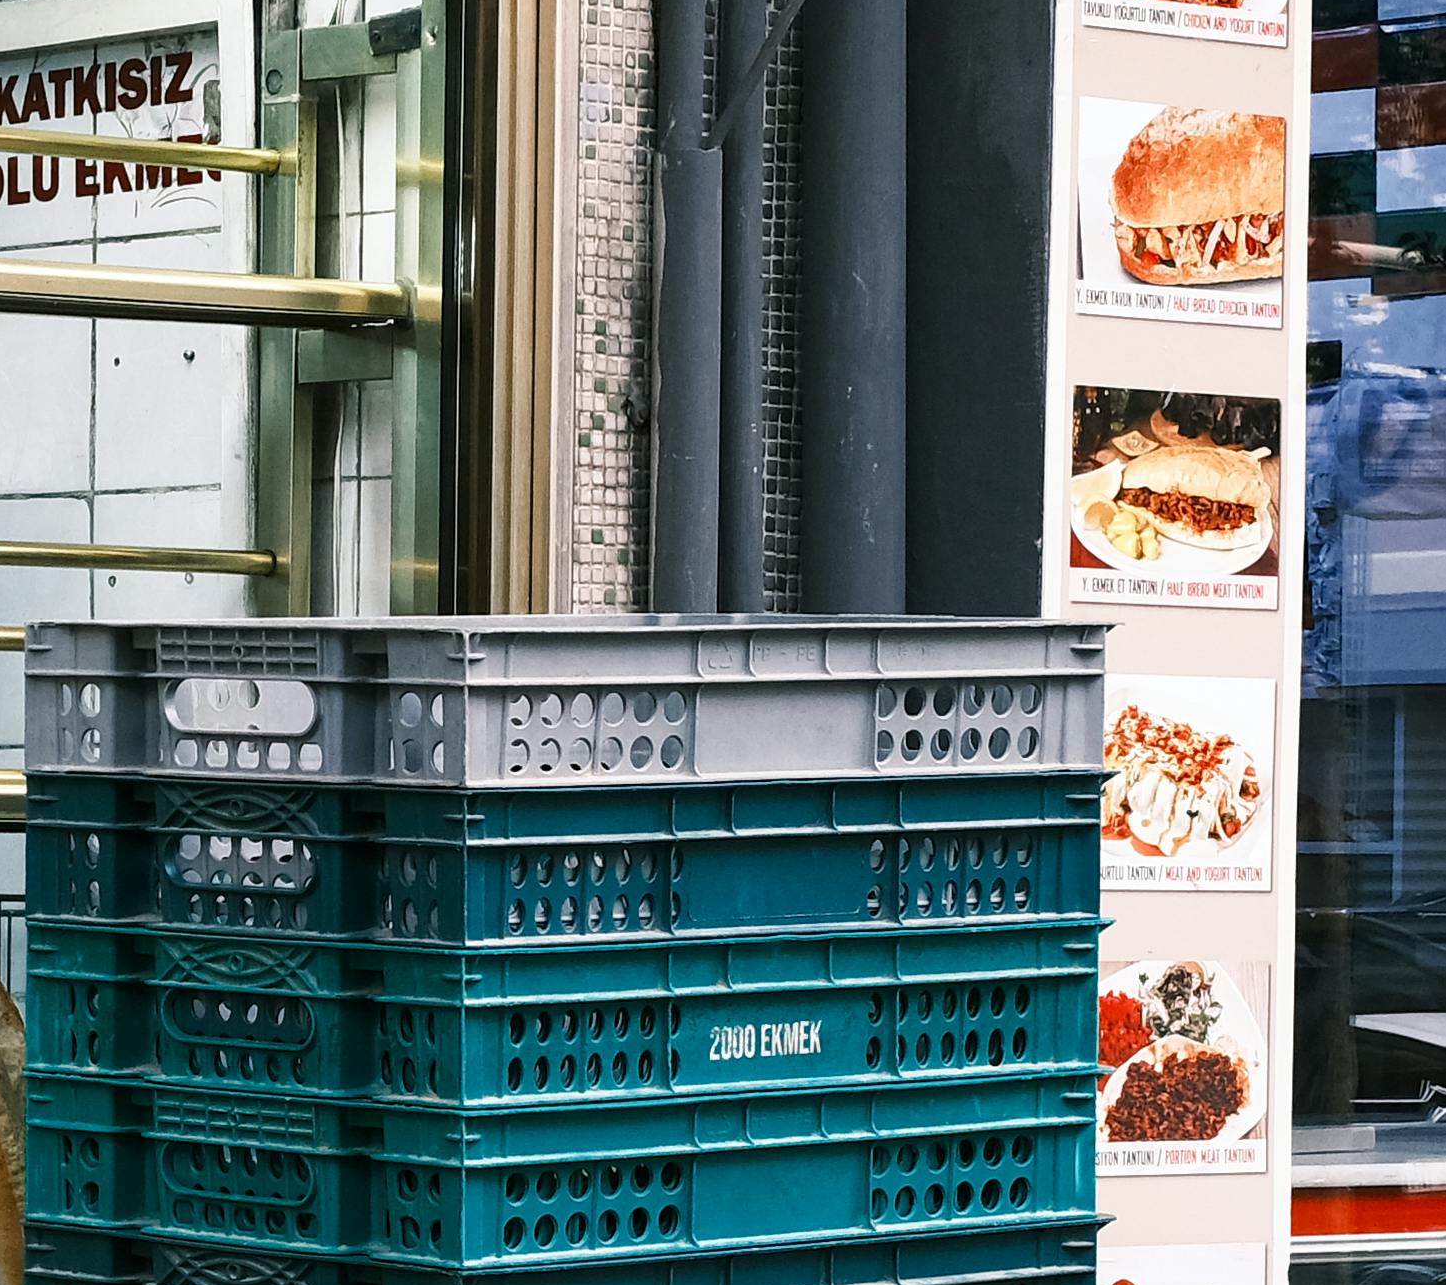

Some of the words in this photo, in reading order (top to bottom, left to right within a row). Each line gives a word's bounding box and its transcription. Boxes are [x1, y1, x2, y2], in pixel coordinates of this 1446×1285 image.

[1183, 13, 1211, 29] CHICKEN
[1213, 17, 1227, 30] AND
[1086, 290, 1108, 305] EKMEK
[1110, 291, 1132, 307] TAVUK
[1173, 296, 1190, 311] HALF
[1193, 298, 1216, 313] BREAD
[1092, 577, 1115, 593] EKMEK
[1117, 579, 1126, 593] ET
[1166, 582, 1184, 595] HALF
[1187, 582, 1209, 597] BREAD
[1213, 583, 1232, 598] MEAT
[1165, 866, 1183, 881] MEAT
[1186, 866, 1201, 881] AND
[709, 1024, 756, 1061] 2000
[760, 1019, 823, 1056] EKMEK
[1165, 1149, 1196, 1164] PORTION
[1201, 1149, 1219, 1163] MEAT
